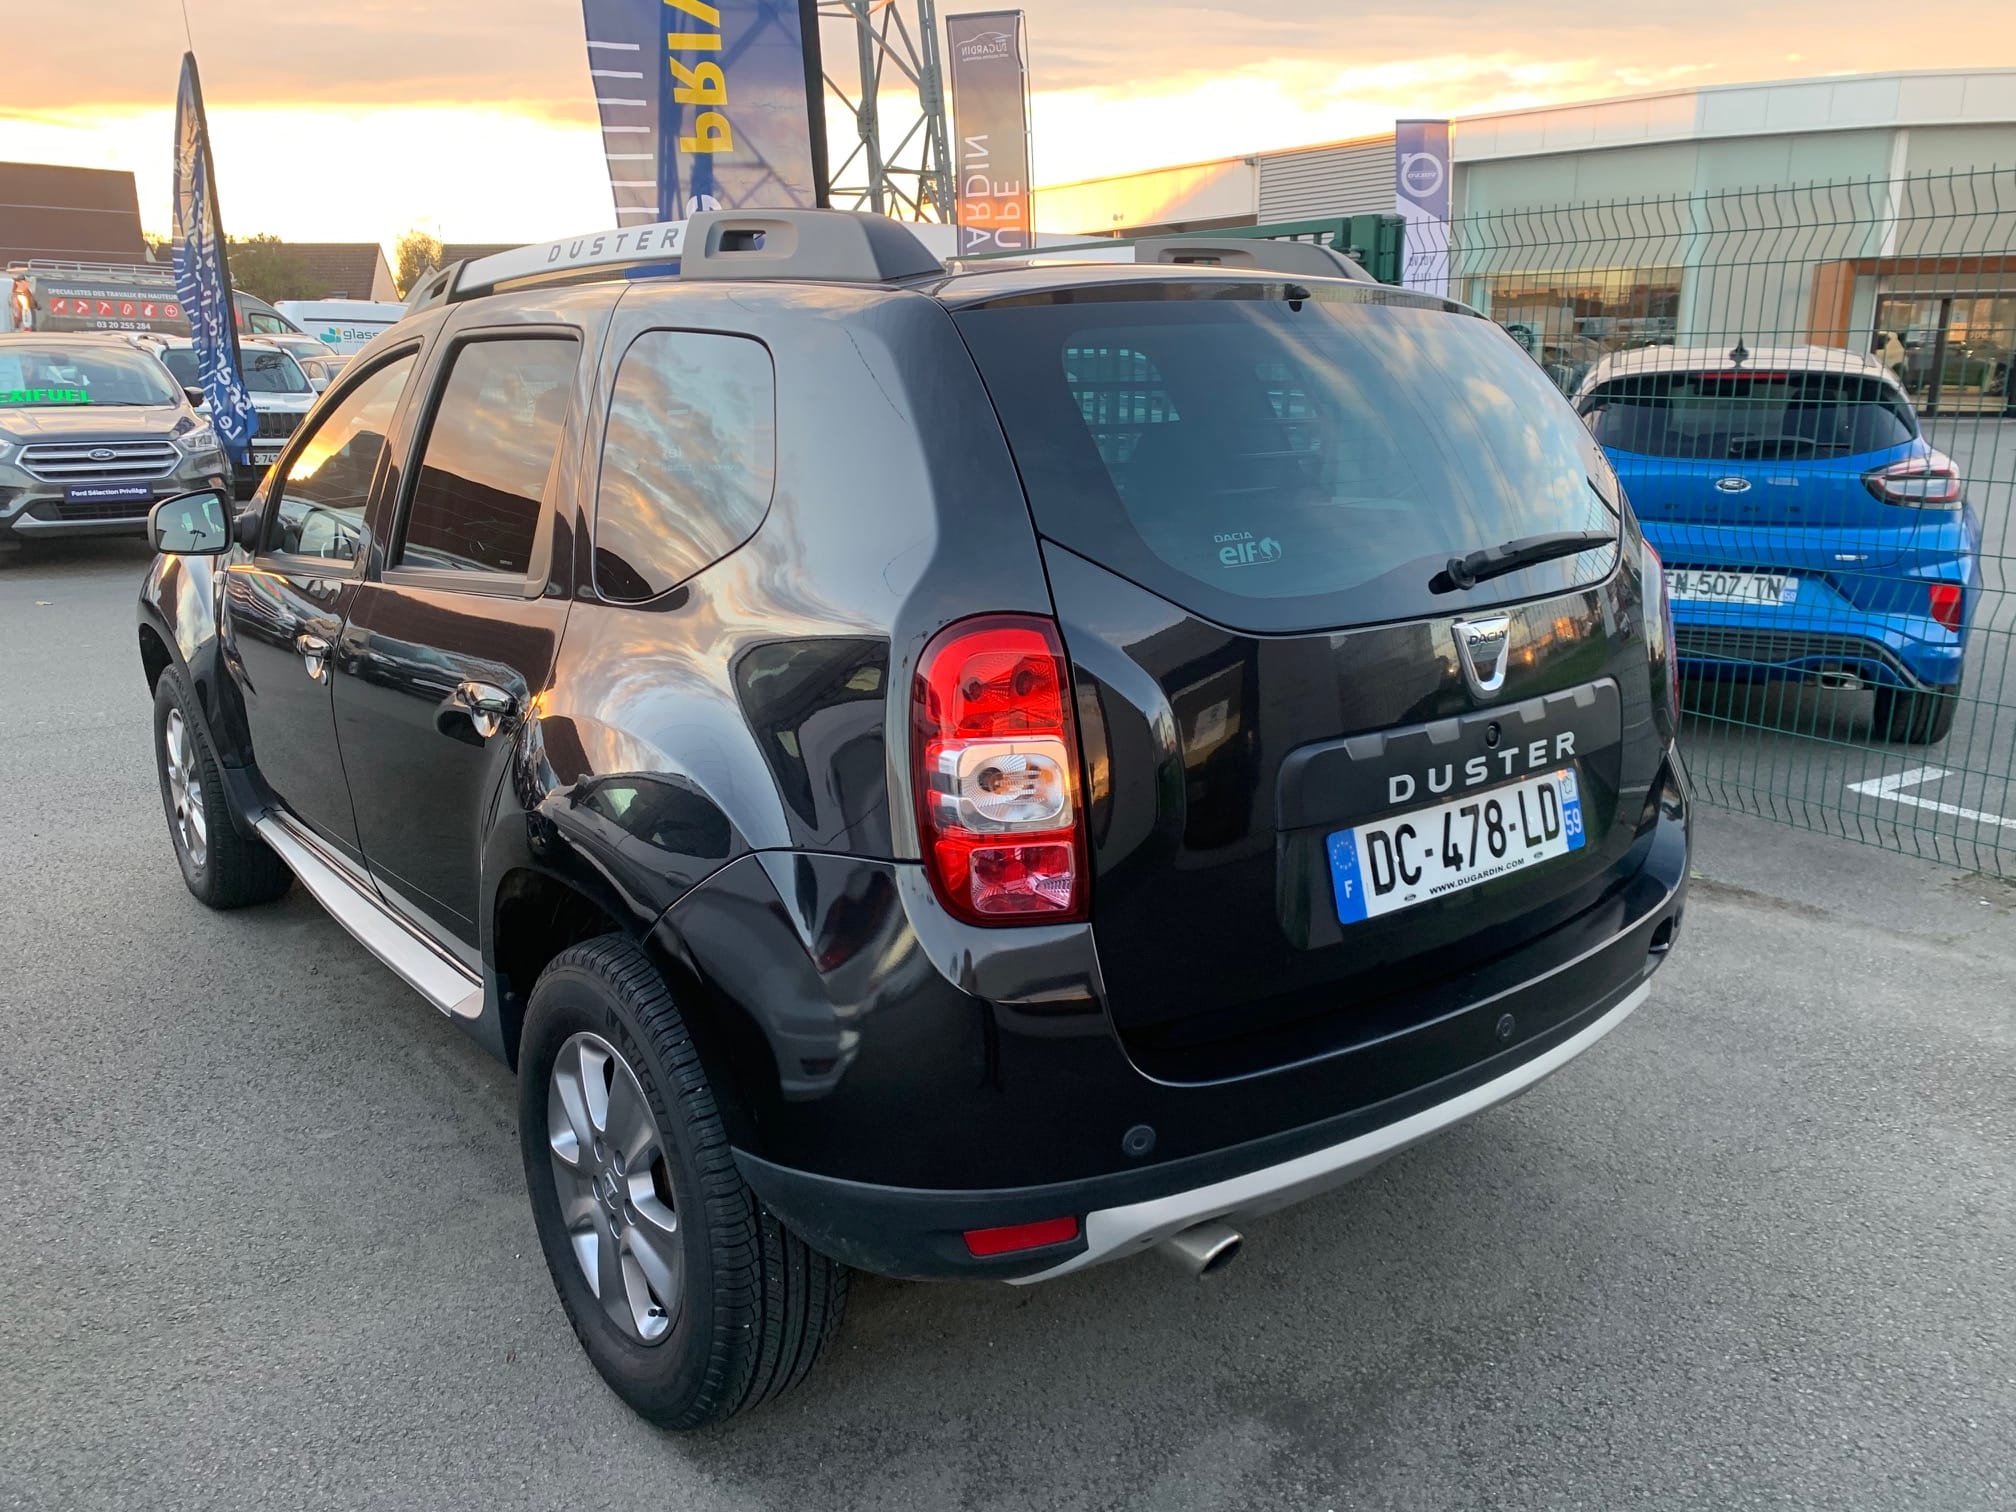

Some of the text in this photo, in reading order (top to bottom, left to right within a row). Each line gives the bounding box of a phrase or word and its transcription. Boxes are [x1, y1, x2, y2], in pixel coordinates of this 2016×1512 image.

[547, 228, 679, 263] DUSTER
[106, 290, 137, 298] TRAVAUX
[108, 321, 119, 329] 20
[136, 322, 151, 330] 284
[71, 489, 87, 497] Ford
[1214, 531, 1253, 543] DACIA
[1219, 541, 1258, 565] elf
[1469, 630, 1505, 645] DACIA
[1389, 731, 1576, 804] DUSTER
[1365, 782, 1583, 896] DC-478-LD 59
[1429, 857, 1525, 895] WWW.DUGARDIN.COM
[1344, 879, 1353, 899] F
